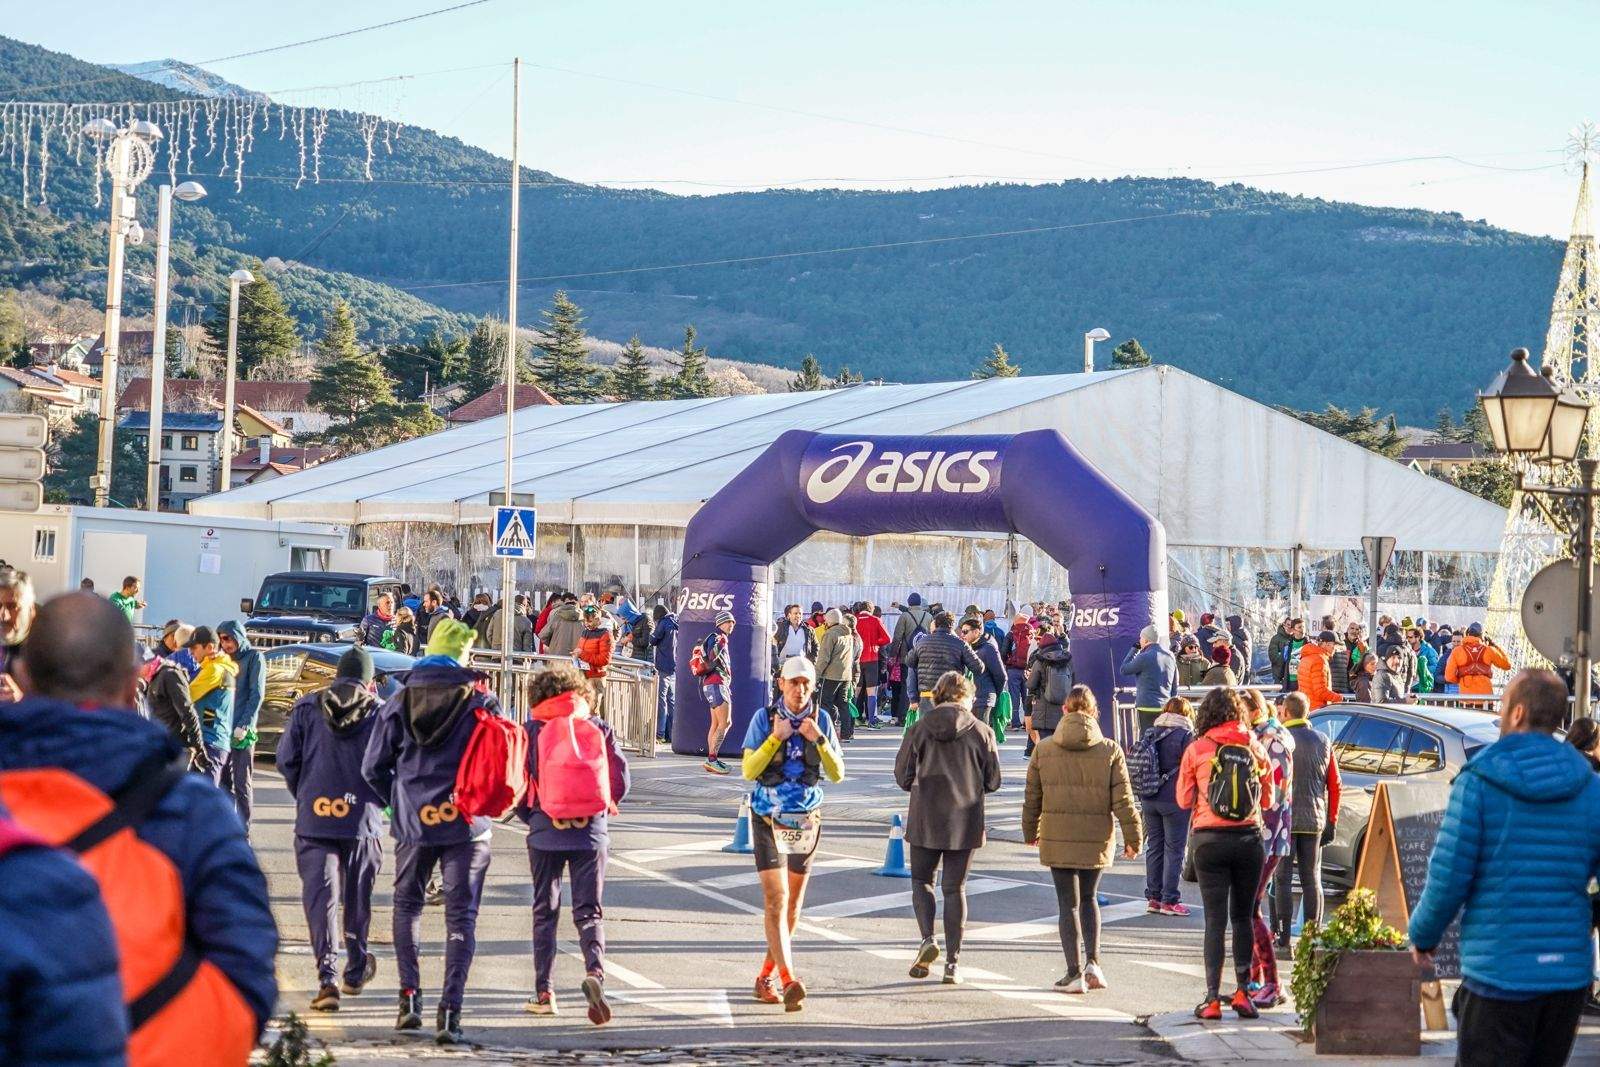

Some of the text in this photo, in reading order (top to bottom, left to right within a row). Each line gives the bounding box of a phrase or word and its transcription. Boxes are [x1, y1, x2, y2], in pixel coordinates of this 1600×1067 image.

[313, 796, 350, 818] GO
[420, 801, 459, 825] GO
[781, 830, 802, 842] 255
